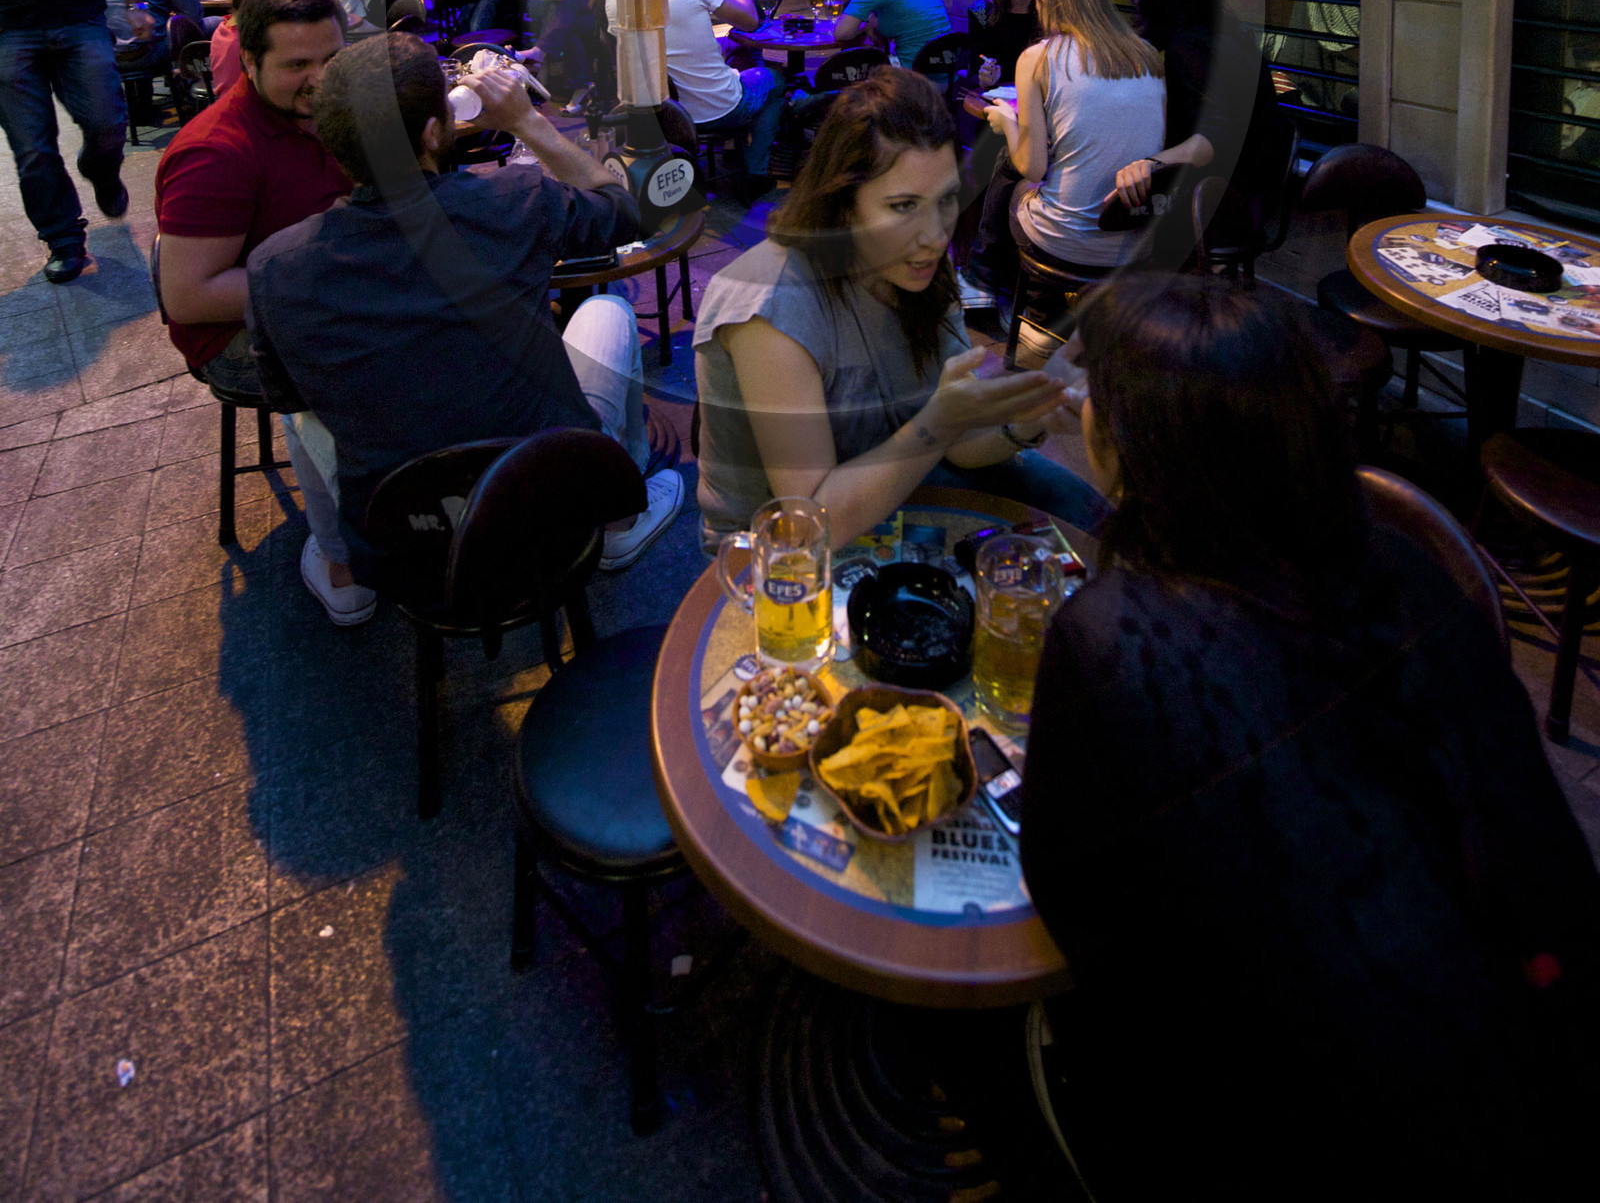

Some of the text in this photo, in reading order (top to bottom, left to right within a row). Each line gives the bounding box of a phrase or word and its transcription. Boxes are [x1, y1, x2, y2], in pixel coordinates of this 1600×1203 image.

[656, 163, 686, 191] EFES
[408, 514, 446, 531] MR.
[767, 581, 803, 597] EFES
[932, 829, 1011, 852] BLUES
[931, 847, 1010, 867] FESTIVAL
